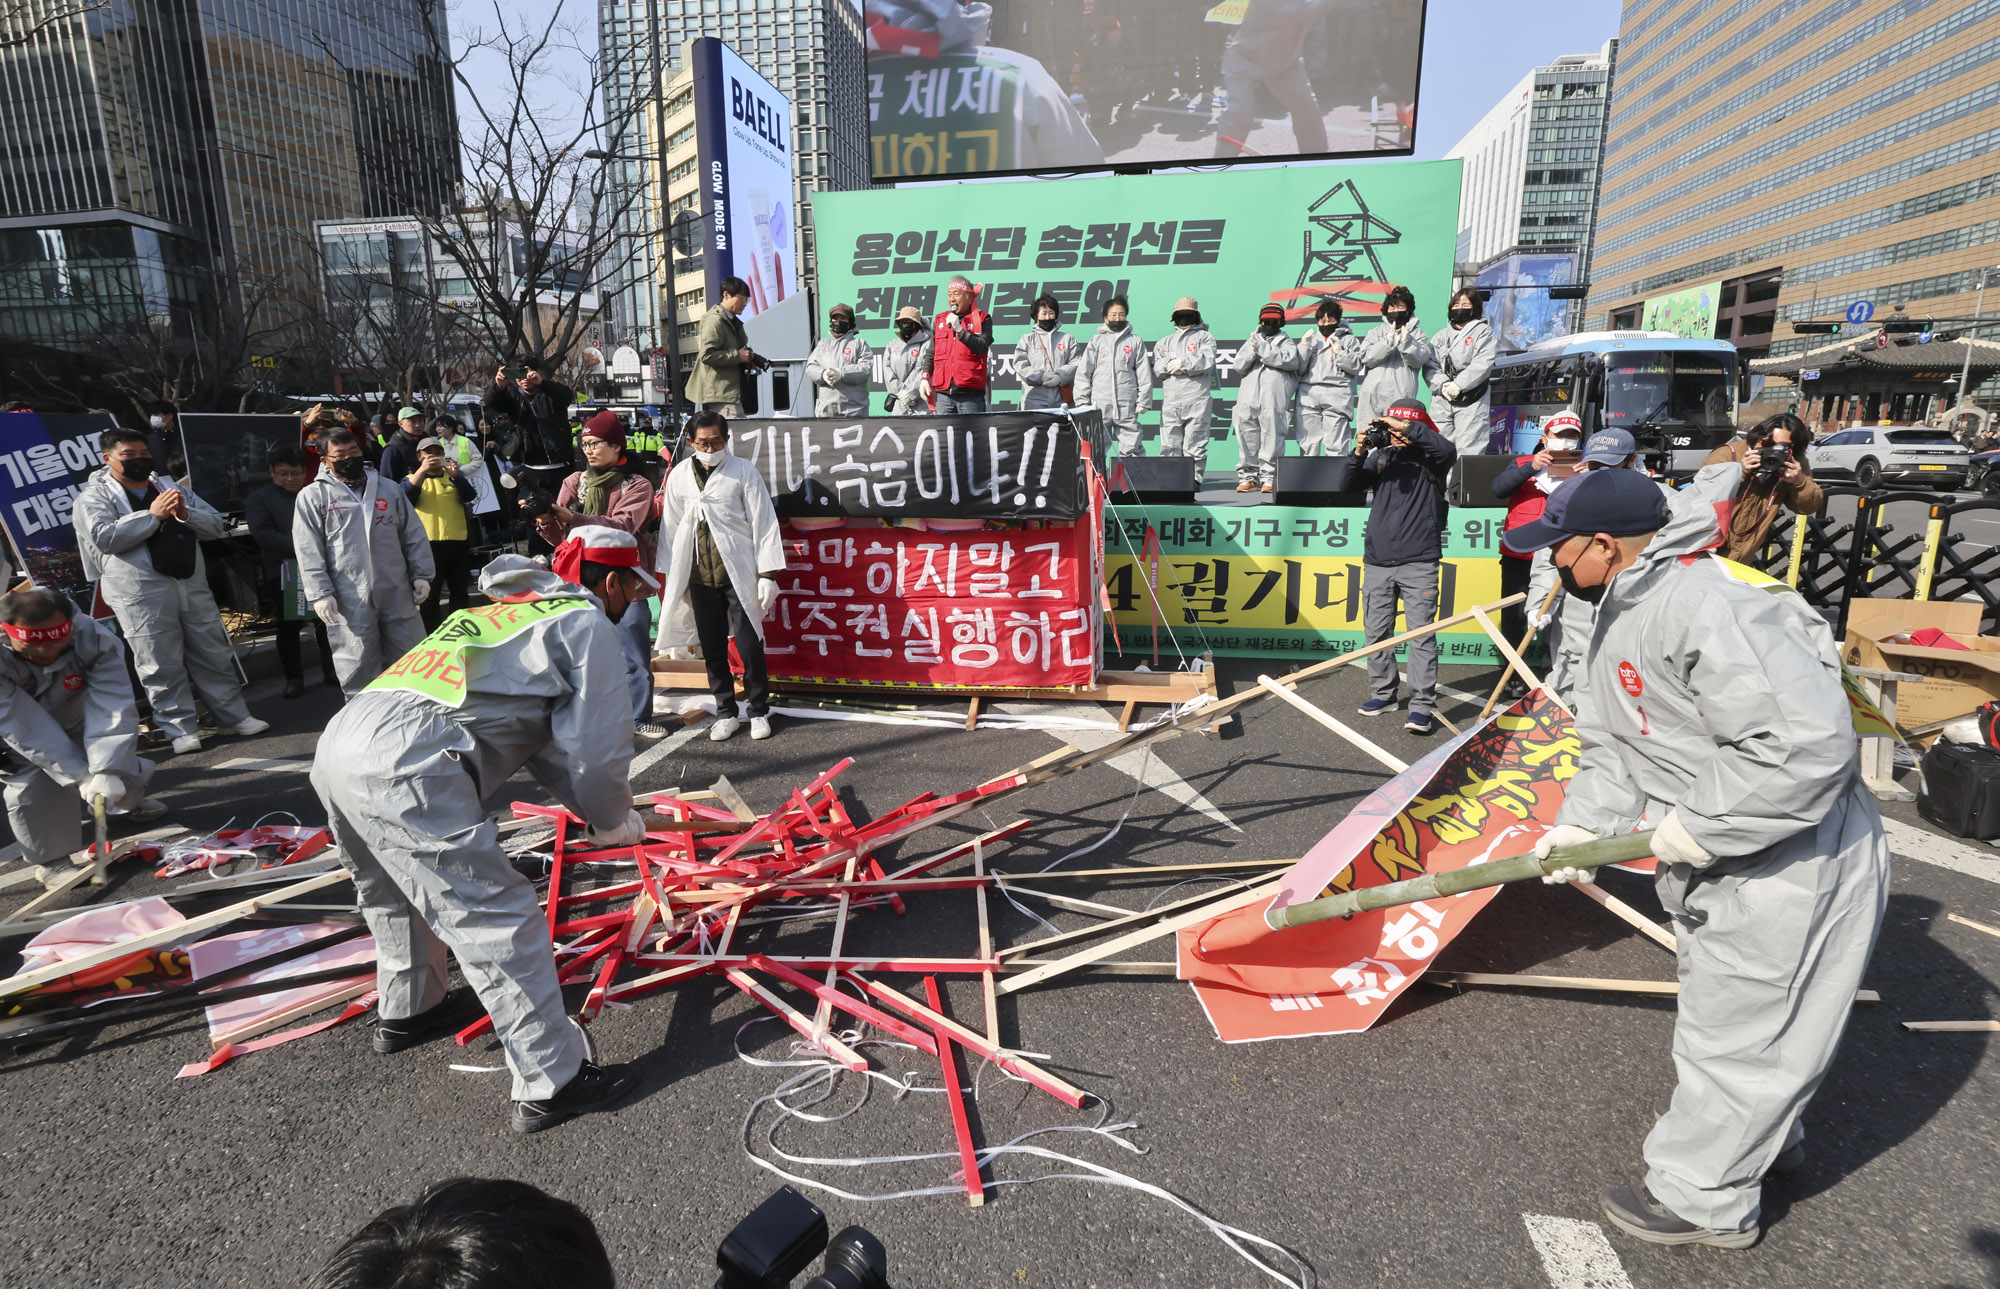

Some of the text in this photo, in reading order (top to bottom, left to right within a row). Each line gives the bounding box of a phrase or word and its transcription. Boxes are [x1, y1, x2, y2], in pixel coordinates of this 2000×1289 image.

[898, 67, 1000, 118] 체제
[731, 76, 785, 153] BAELL
[711, 161, 727, 250] GLOW MODE ON
[374, 223, 384, 232] Art
[384, 221, 418, 231] Exhibition
[851, 219, 1227, 276] 용인산단 송전선로
[855, 285, 938, 330] 전면
[1389, 409, 1419, 419] 결사반대
[1588, 436, 1620, 448] CAPRICORN
[1159, 517, 1215, 547] 대화
[1225, 518, 1282, 548] 기구
[1292, 518, 1349, 548] 구성
[1182, 635, 1241, 650] 국가산단
[1246, 636, 1305, 651] 재검토와
[1310, 637, 1357, 654] 초고압
[1451, 642, 1482, 657] 반대
